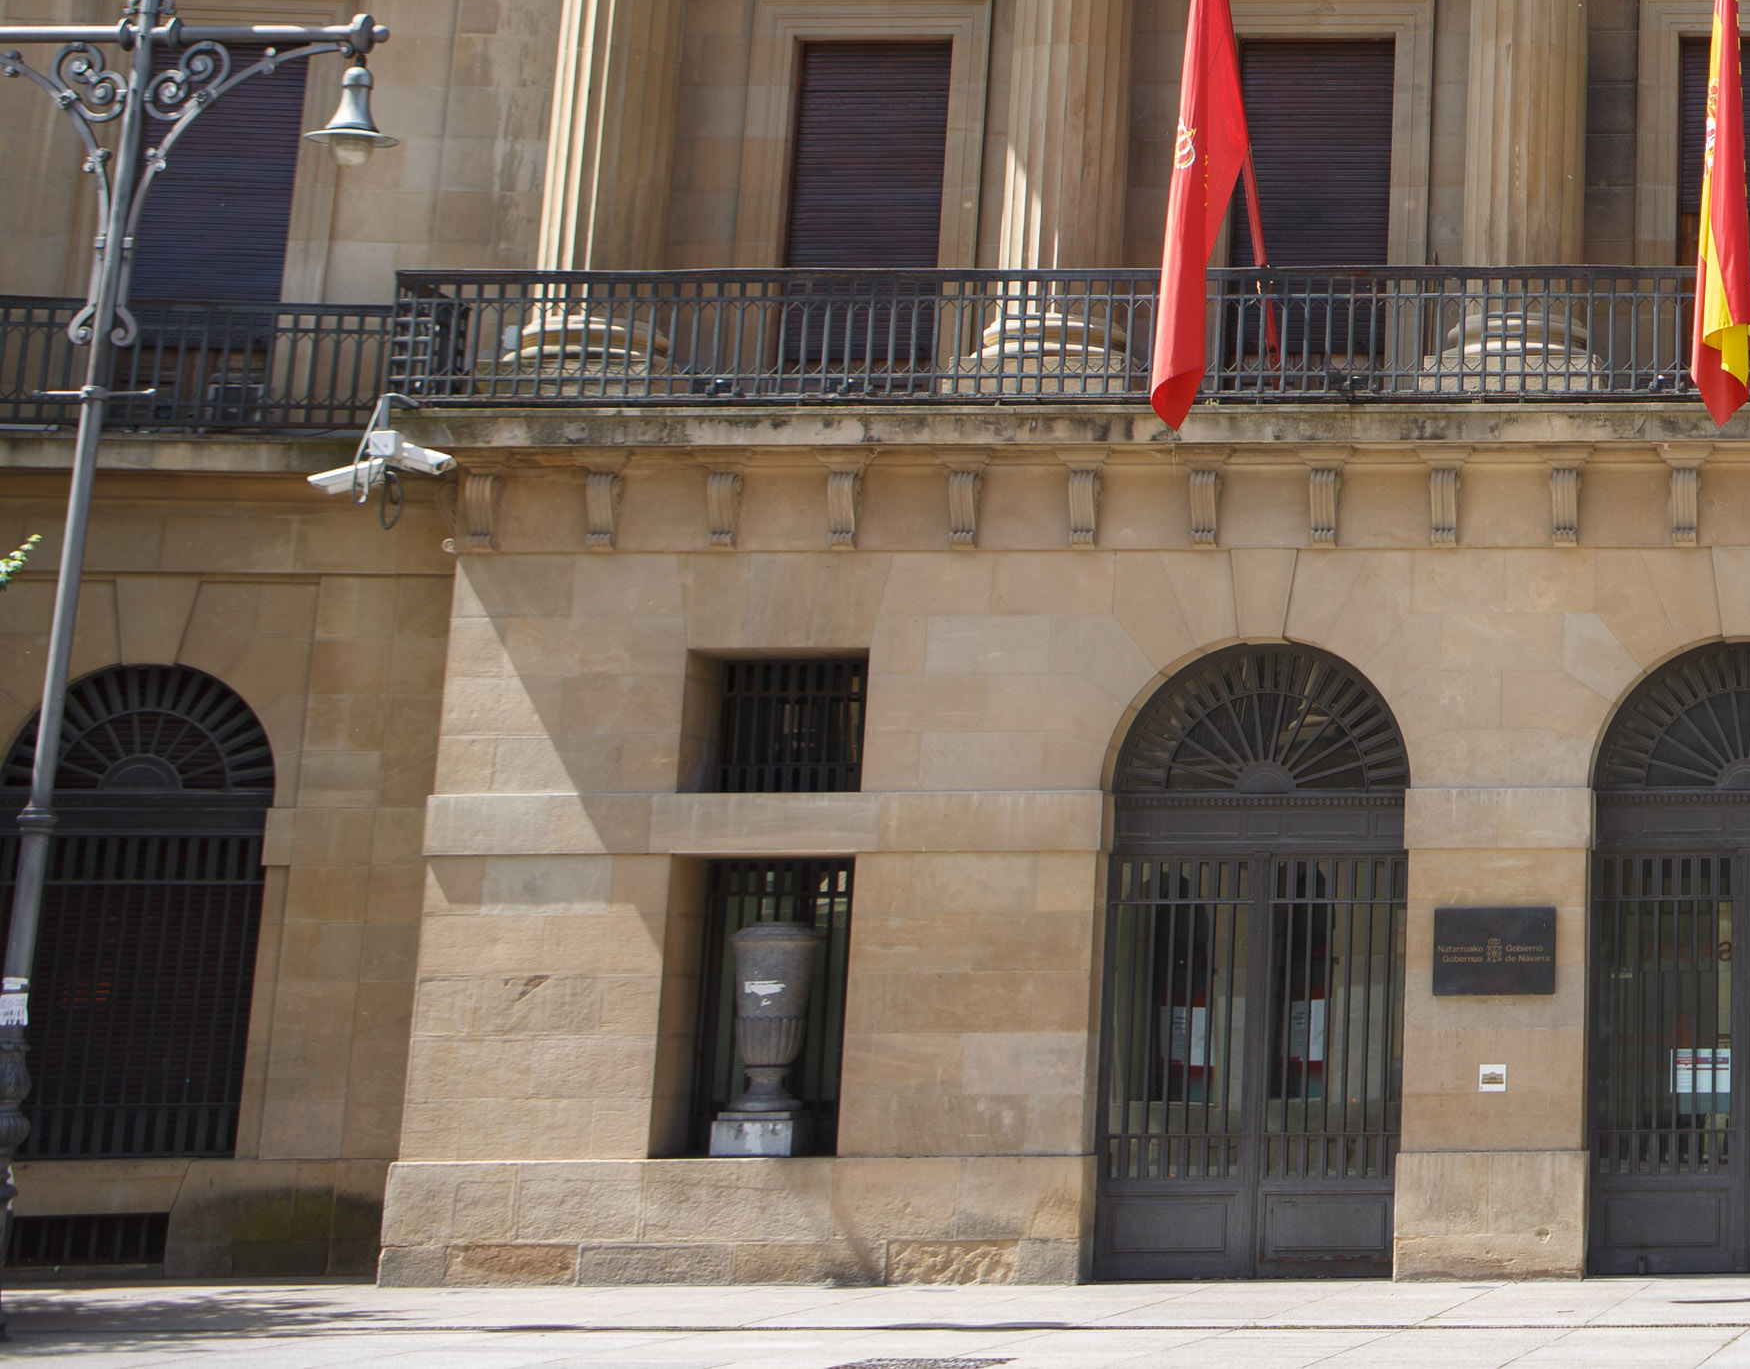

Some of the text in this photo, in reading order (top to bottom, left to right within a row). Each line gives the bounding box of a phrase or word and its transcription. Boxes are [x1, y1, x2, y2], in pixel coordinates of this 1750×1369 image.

[1437, 944, 1484, 953] Nafarroako
[1505, 943, 1544, 953] Gobierno
[1442, 954, 1483, 963] Gobernua
[1505, 954, 1551, 963] de Navarra
